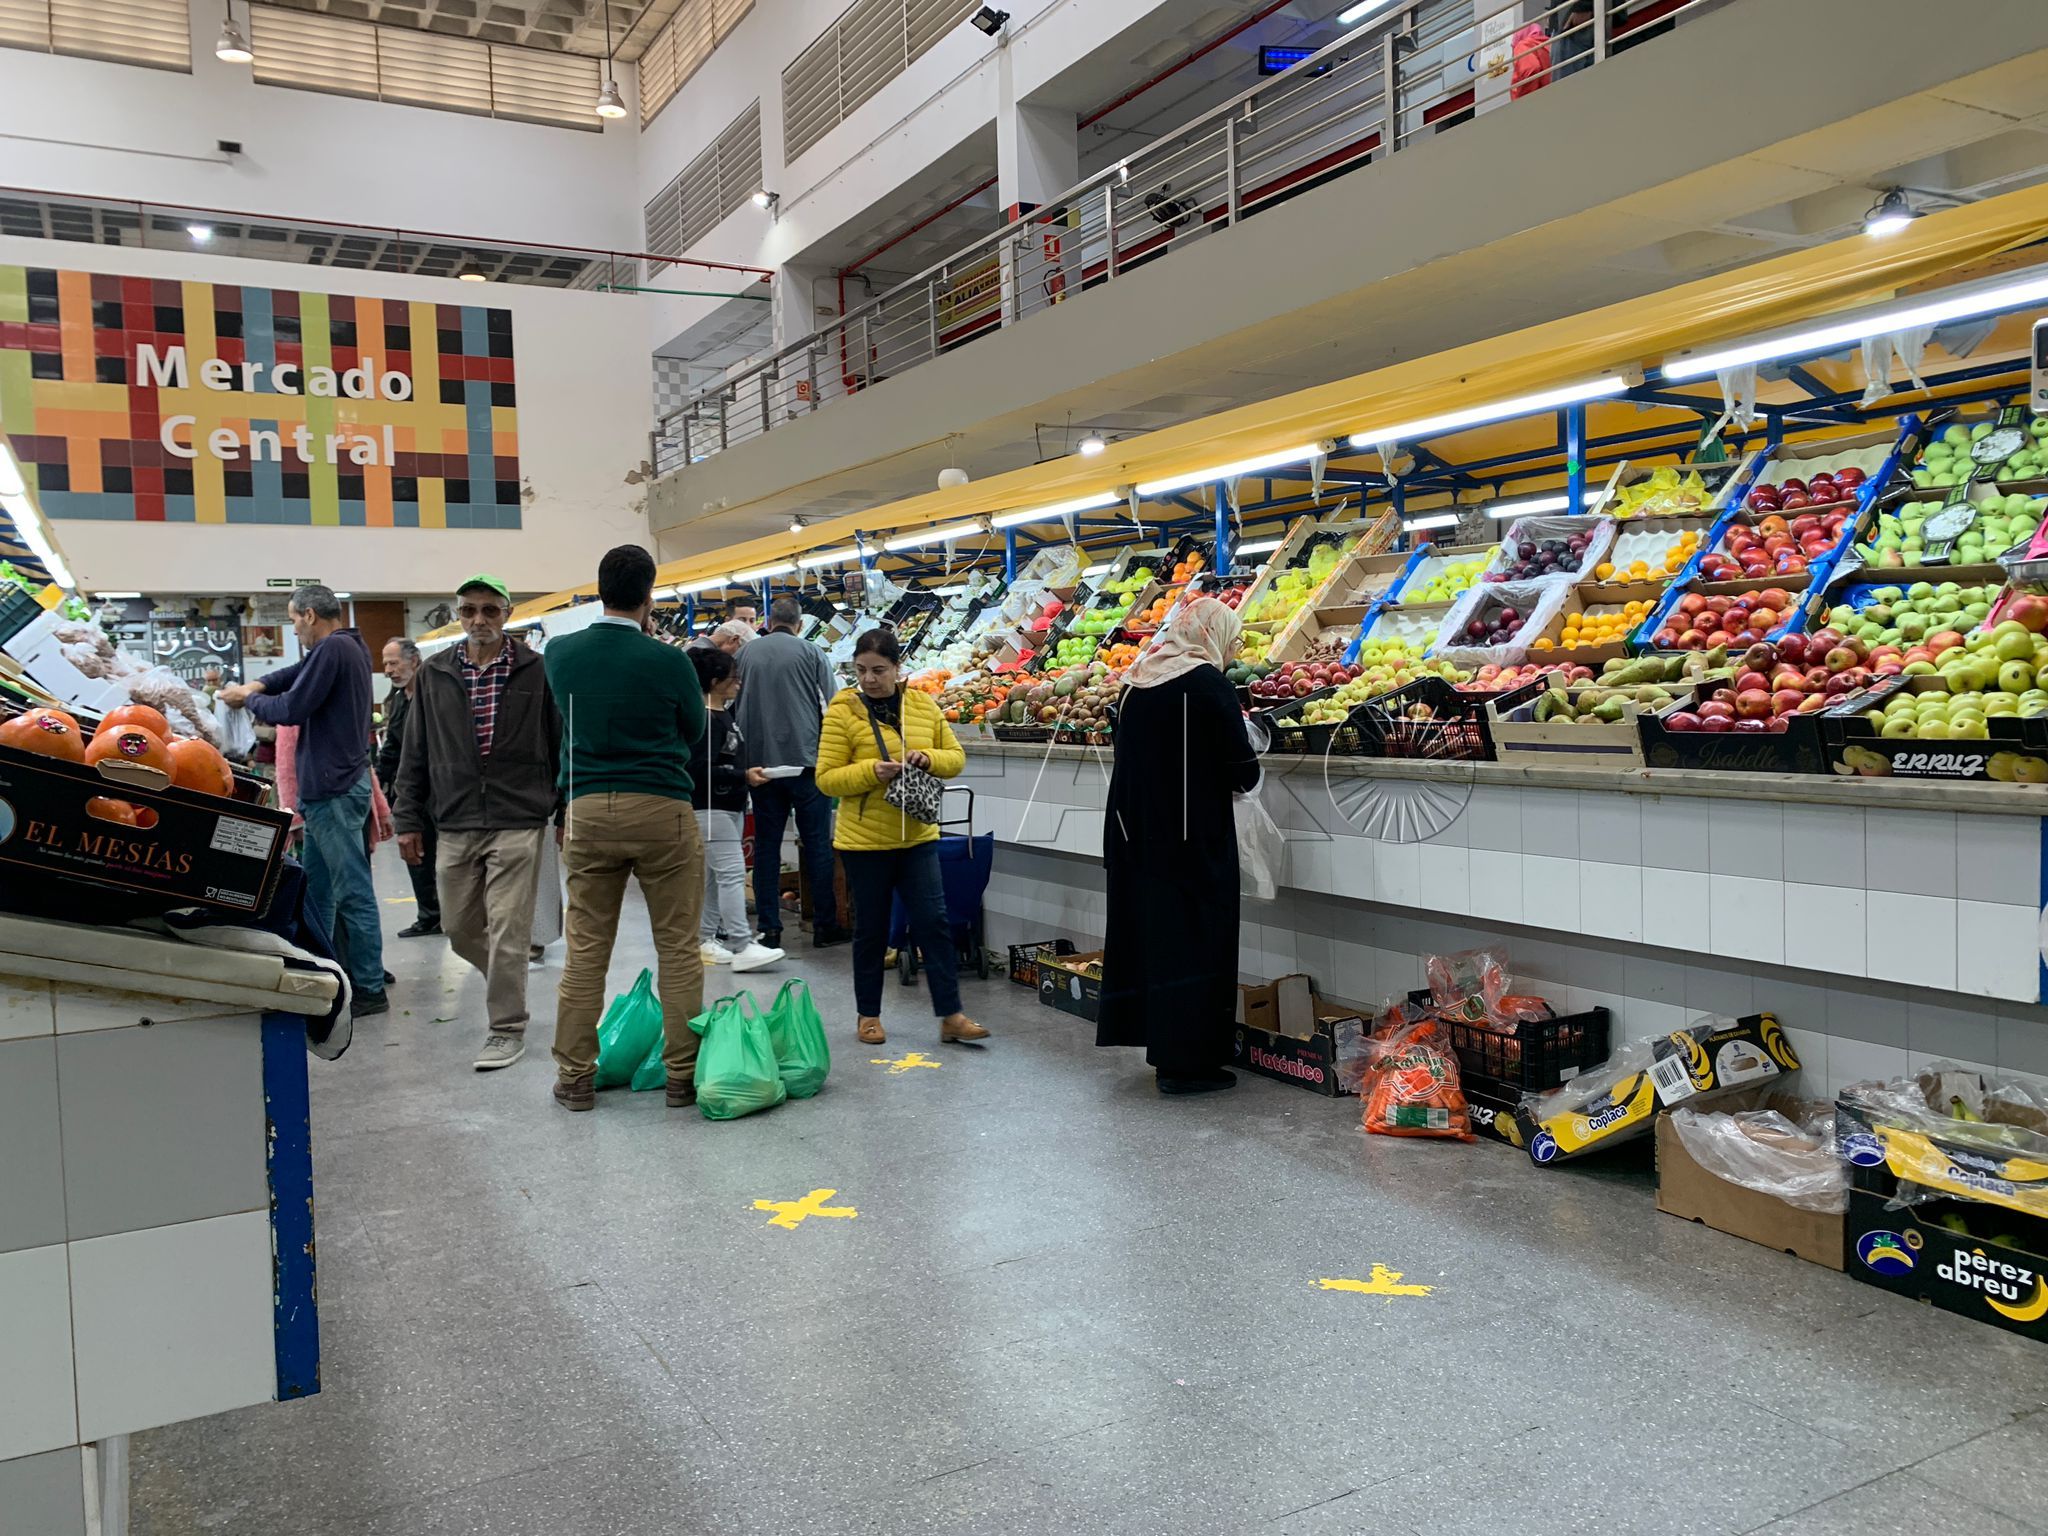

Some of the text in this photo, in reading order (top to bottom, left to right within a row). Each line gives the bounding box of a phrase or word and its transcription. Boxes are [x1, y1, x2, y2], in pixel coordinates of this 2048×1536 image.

[135, 343, 413, 402] Mercado
[160, 414, 396, 467] Central
[1698, 738, 1781, 768] Isabelle
[1891, 752, 1985, 776] ERRUZ
[23, 820, 64, 847] EL
[76, 831, 193, 875] MESÍAS
[1250, 1046, 1324, 1084] Platónico
[1588, 1106, 1628, 1131] Coplaca
[1948, 1166, 2017, 1197] Coplaca
[1937, 1262, 2018, 1301] abreu
